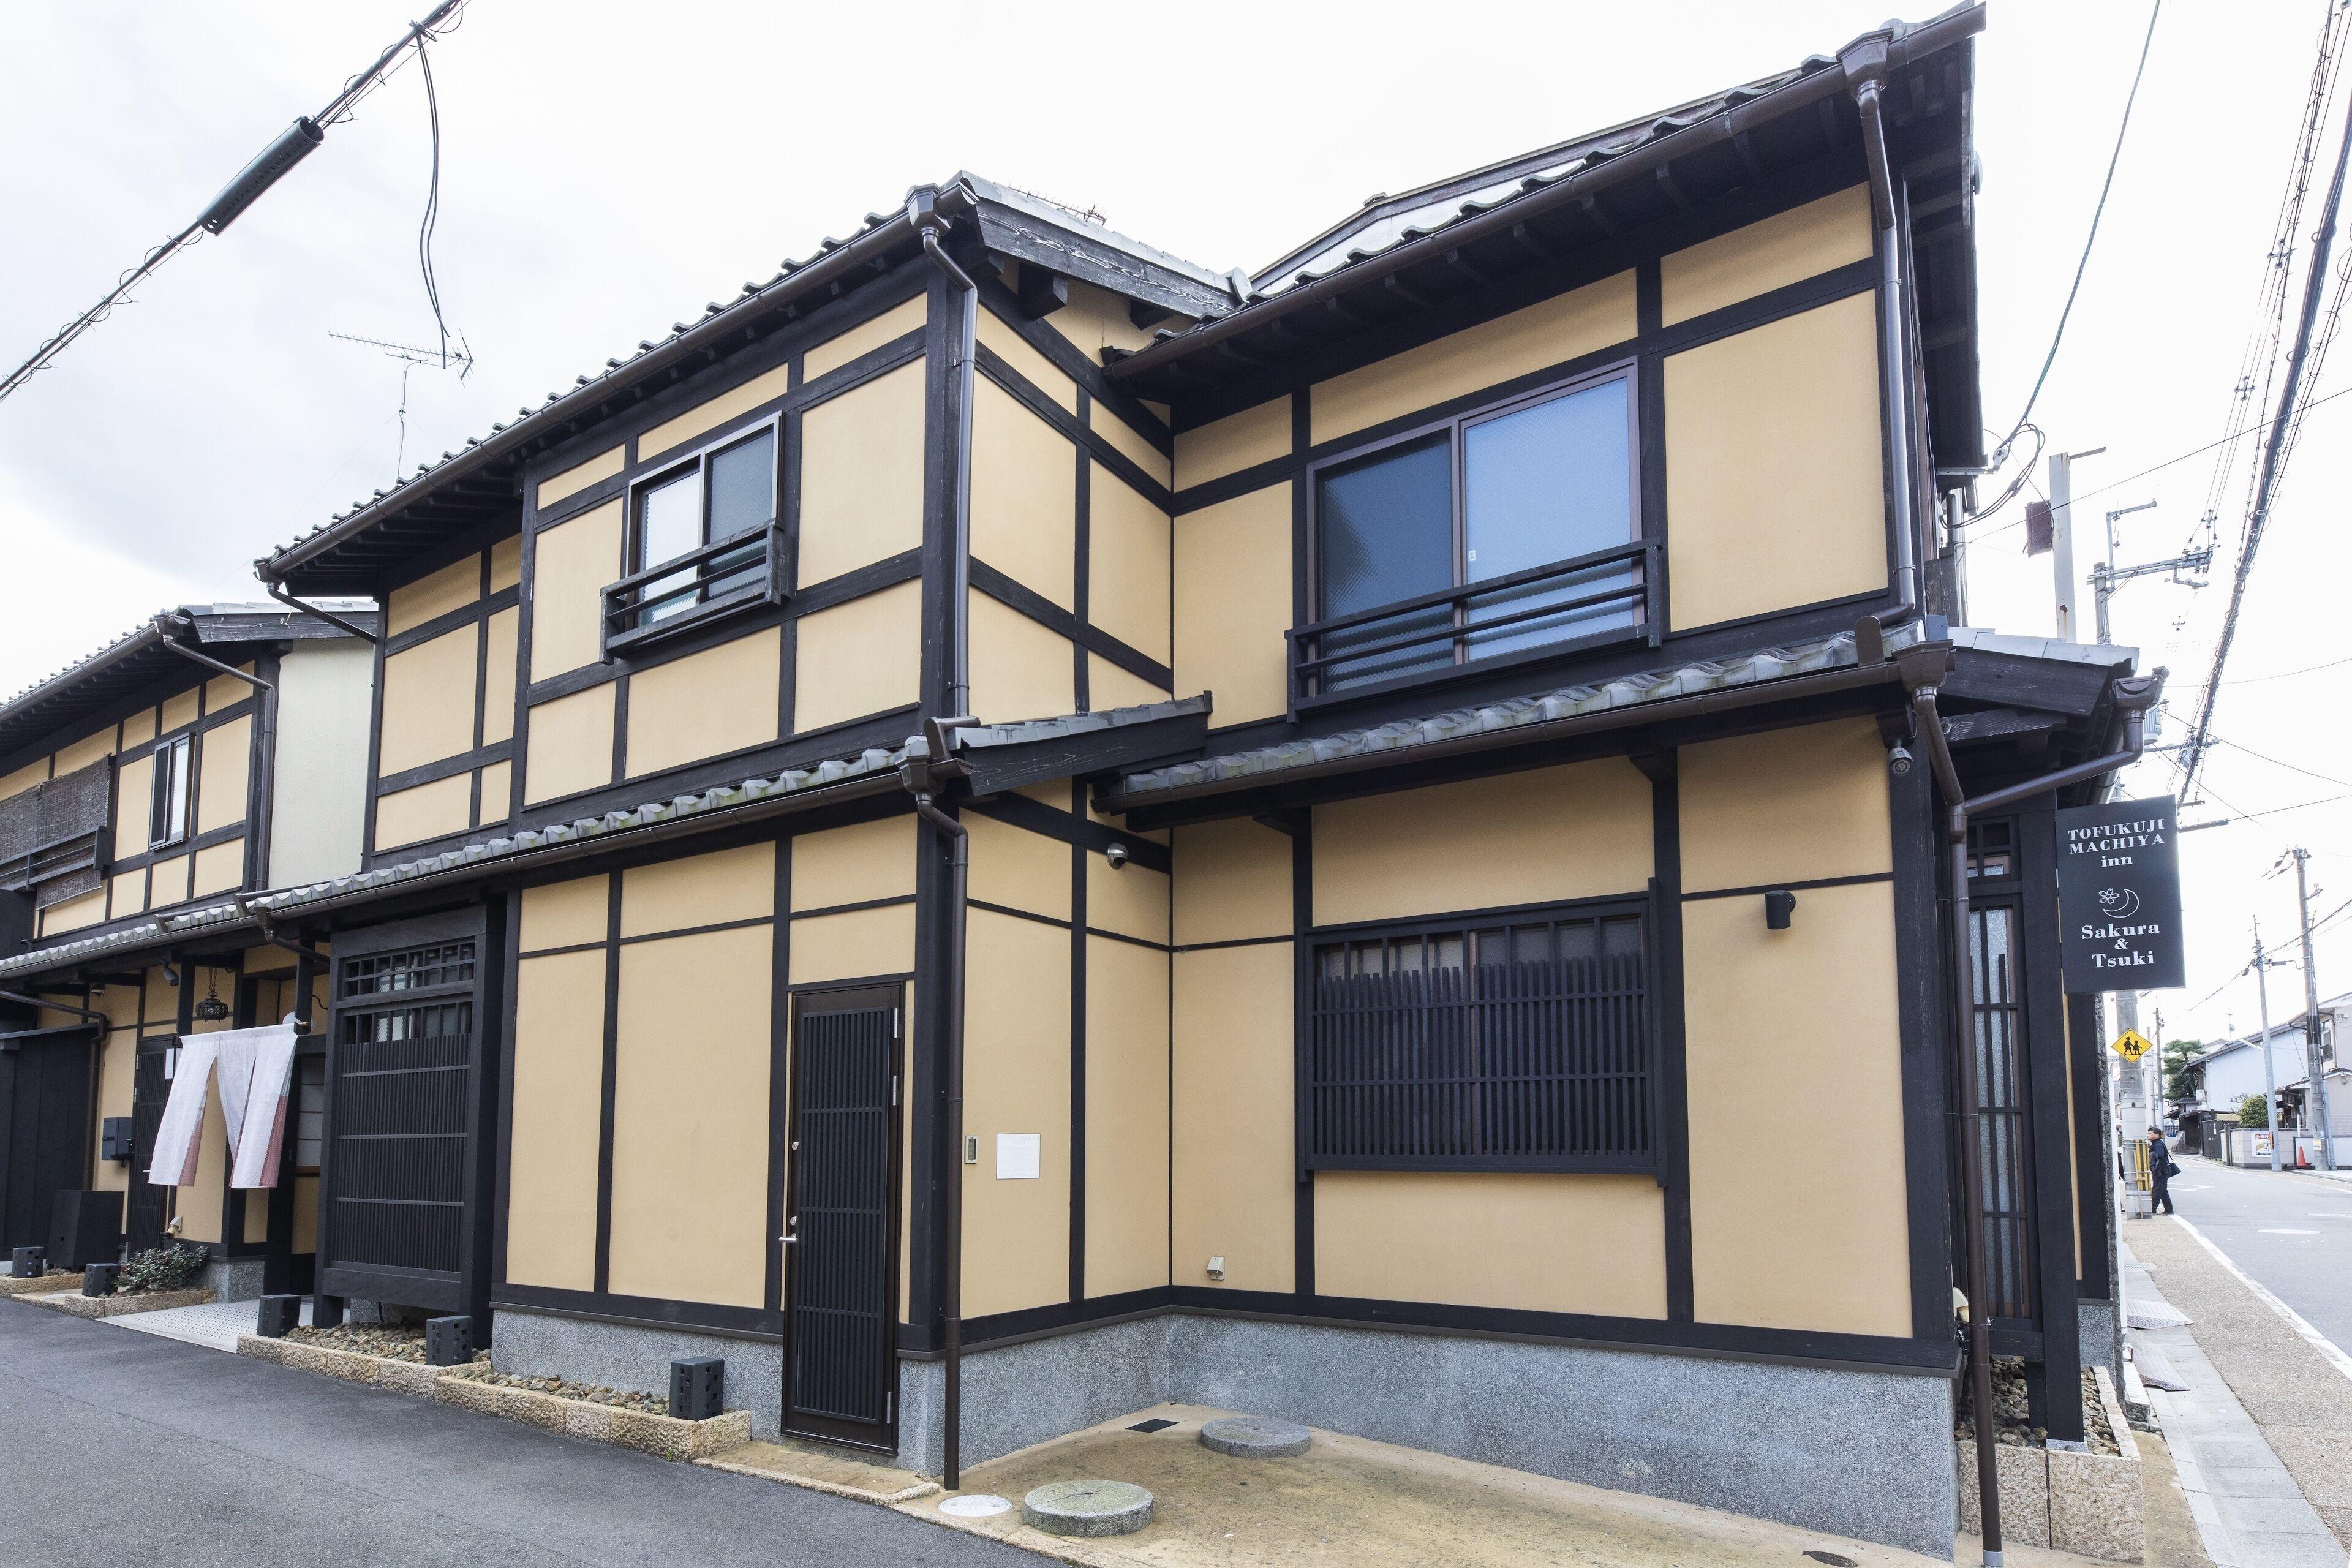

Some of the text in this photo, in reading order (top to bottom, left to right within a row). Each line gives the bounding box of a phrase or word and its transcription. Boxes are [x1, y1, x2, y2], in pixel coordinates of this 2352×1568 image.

[2067, 818, 2165, 840] TOFUKUJI
[2068, 833, 2165, 854] MACHIYA
[2101, 855, 2133, 867] inn
[2081, 923, 2161, 940] Sakura
[2114, 938, 2129, 950] &
[2091, 950, 2154, 968] Tsuki
